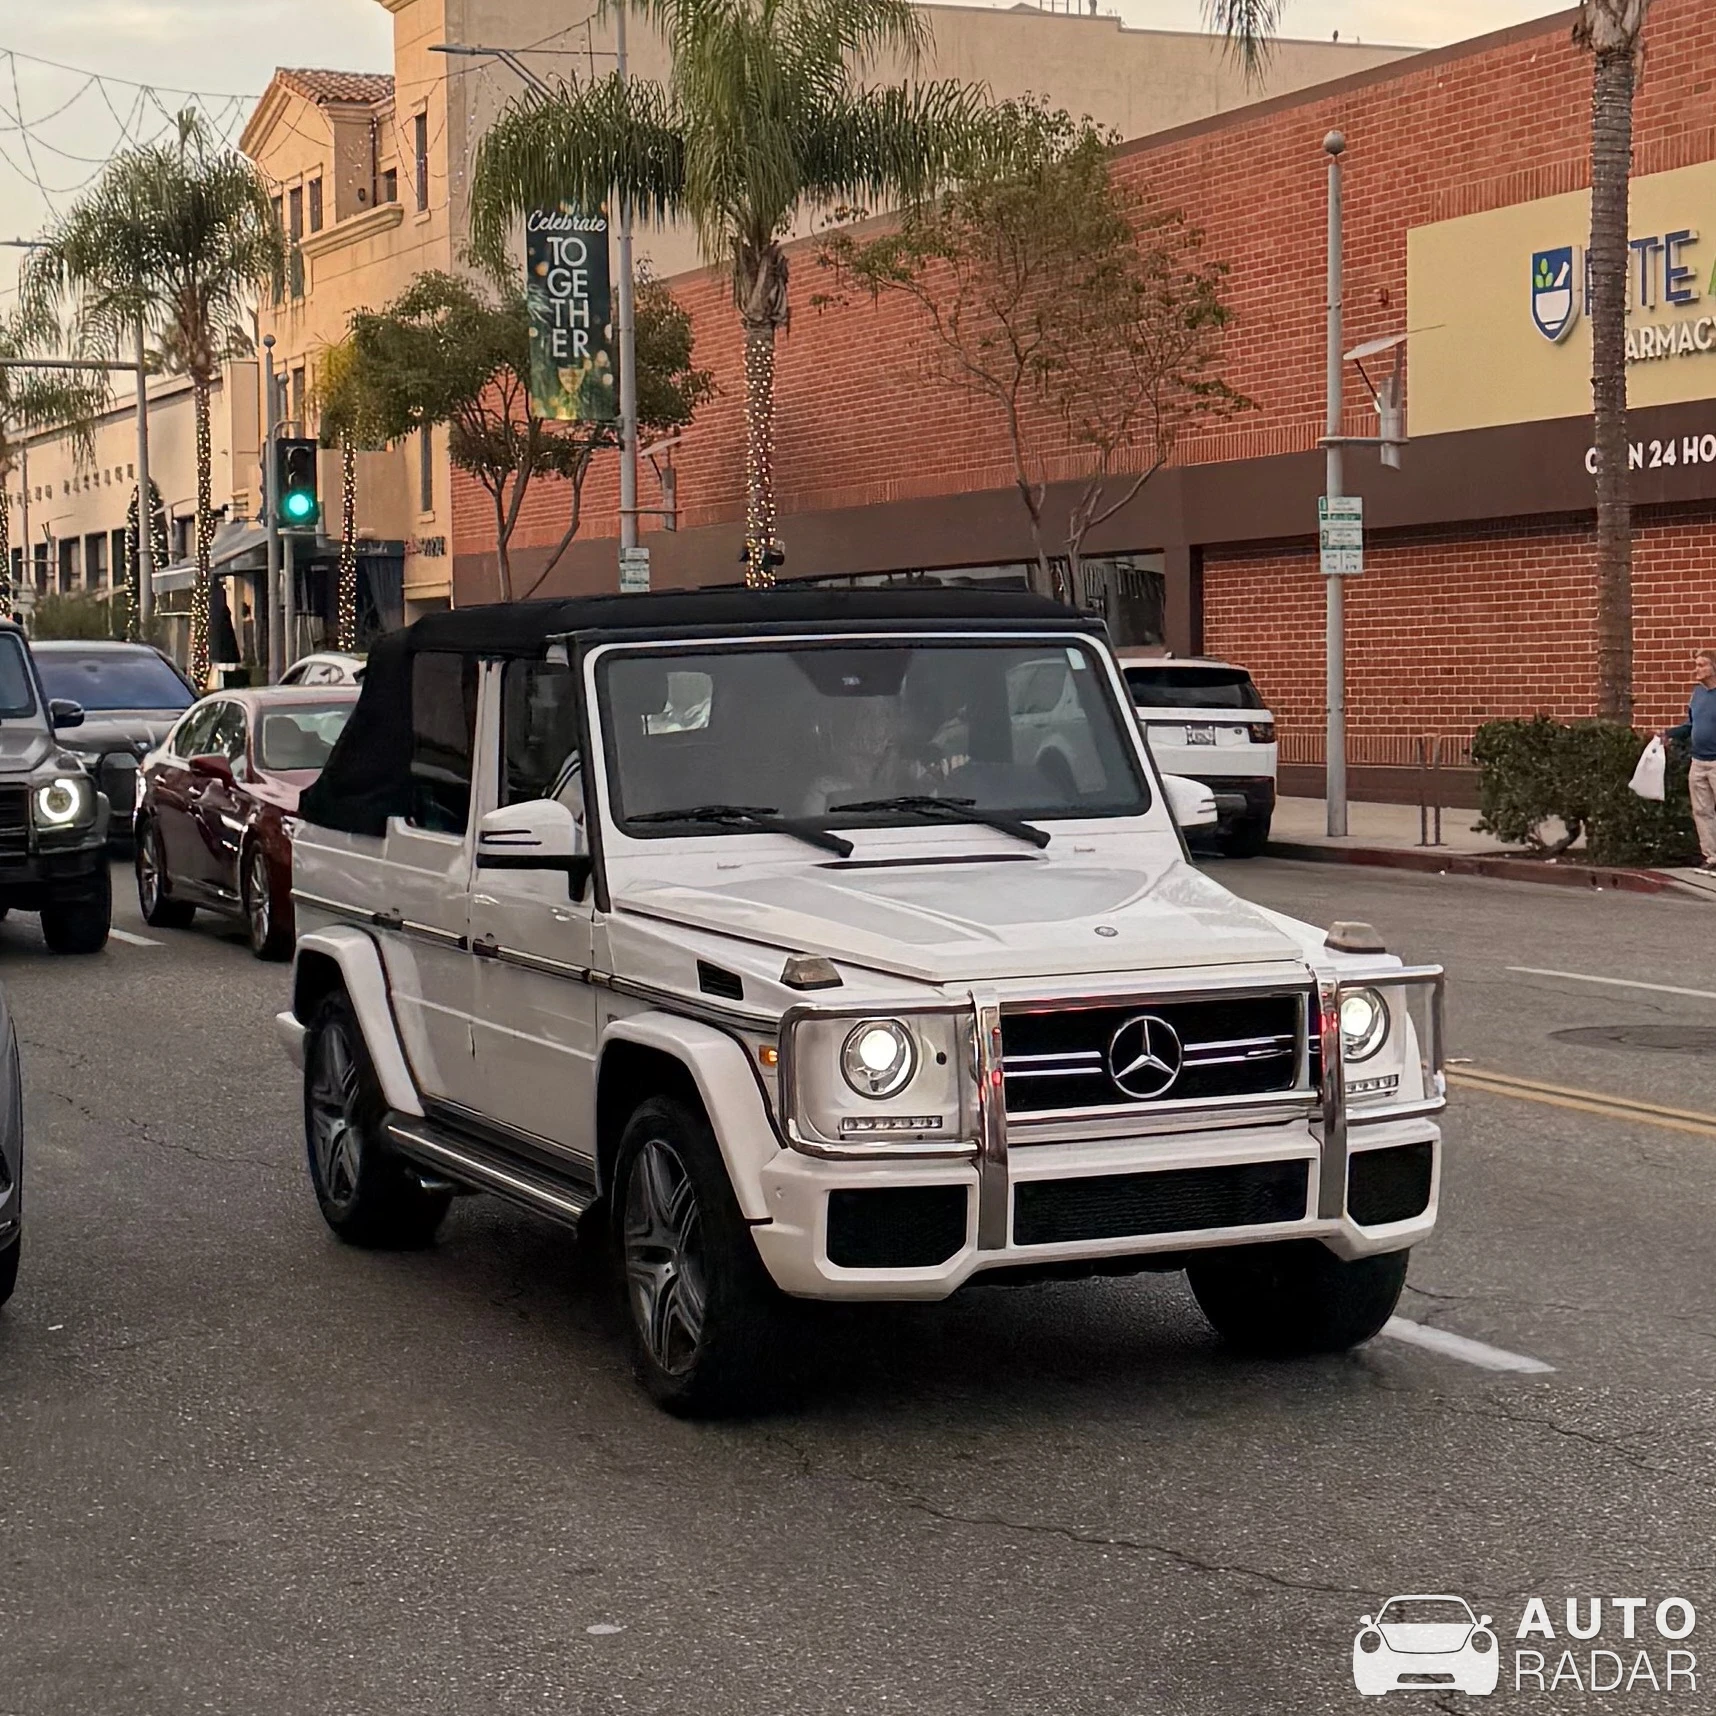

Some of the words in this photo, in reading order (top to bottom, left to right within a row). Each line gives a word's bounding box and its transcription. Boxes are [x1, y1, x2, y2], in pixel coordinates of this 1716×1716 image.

[528, 209, 607, 232] Celebrate
[547, 236, 588, 267] TO
[547, 268, 589, 298] GE
[1584, 229, 1699, 316] TE
[549, 299, 590, 328] TH
[552, 329, 591, 358] ER
[1624, 315, 1716, 361] ARMAC
[1585, 442, 1643, 474] ON
[1649, 440, 1677, 468] 24
